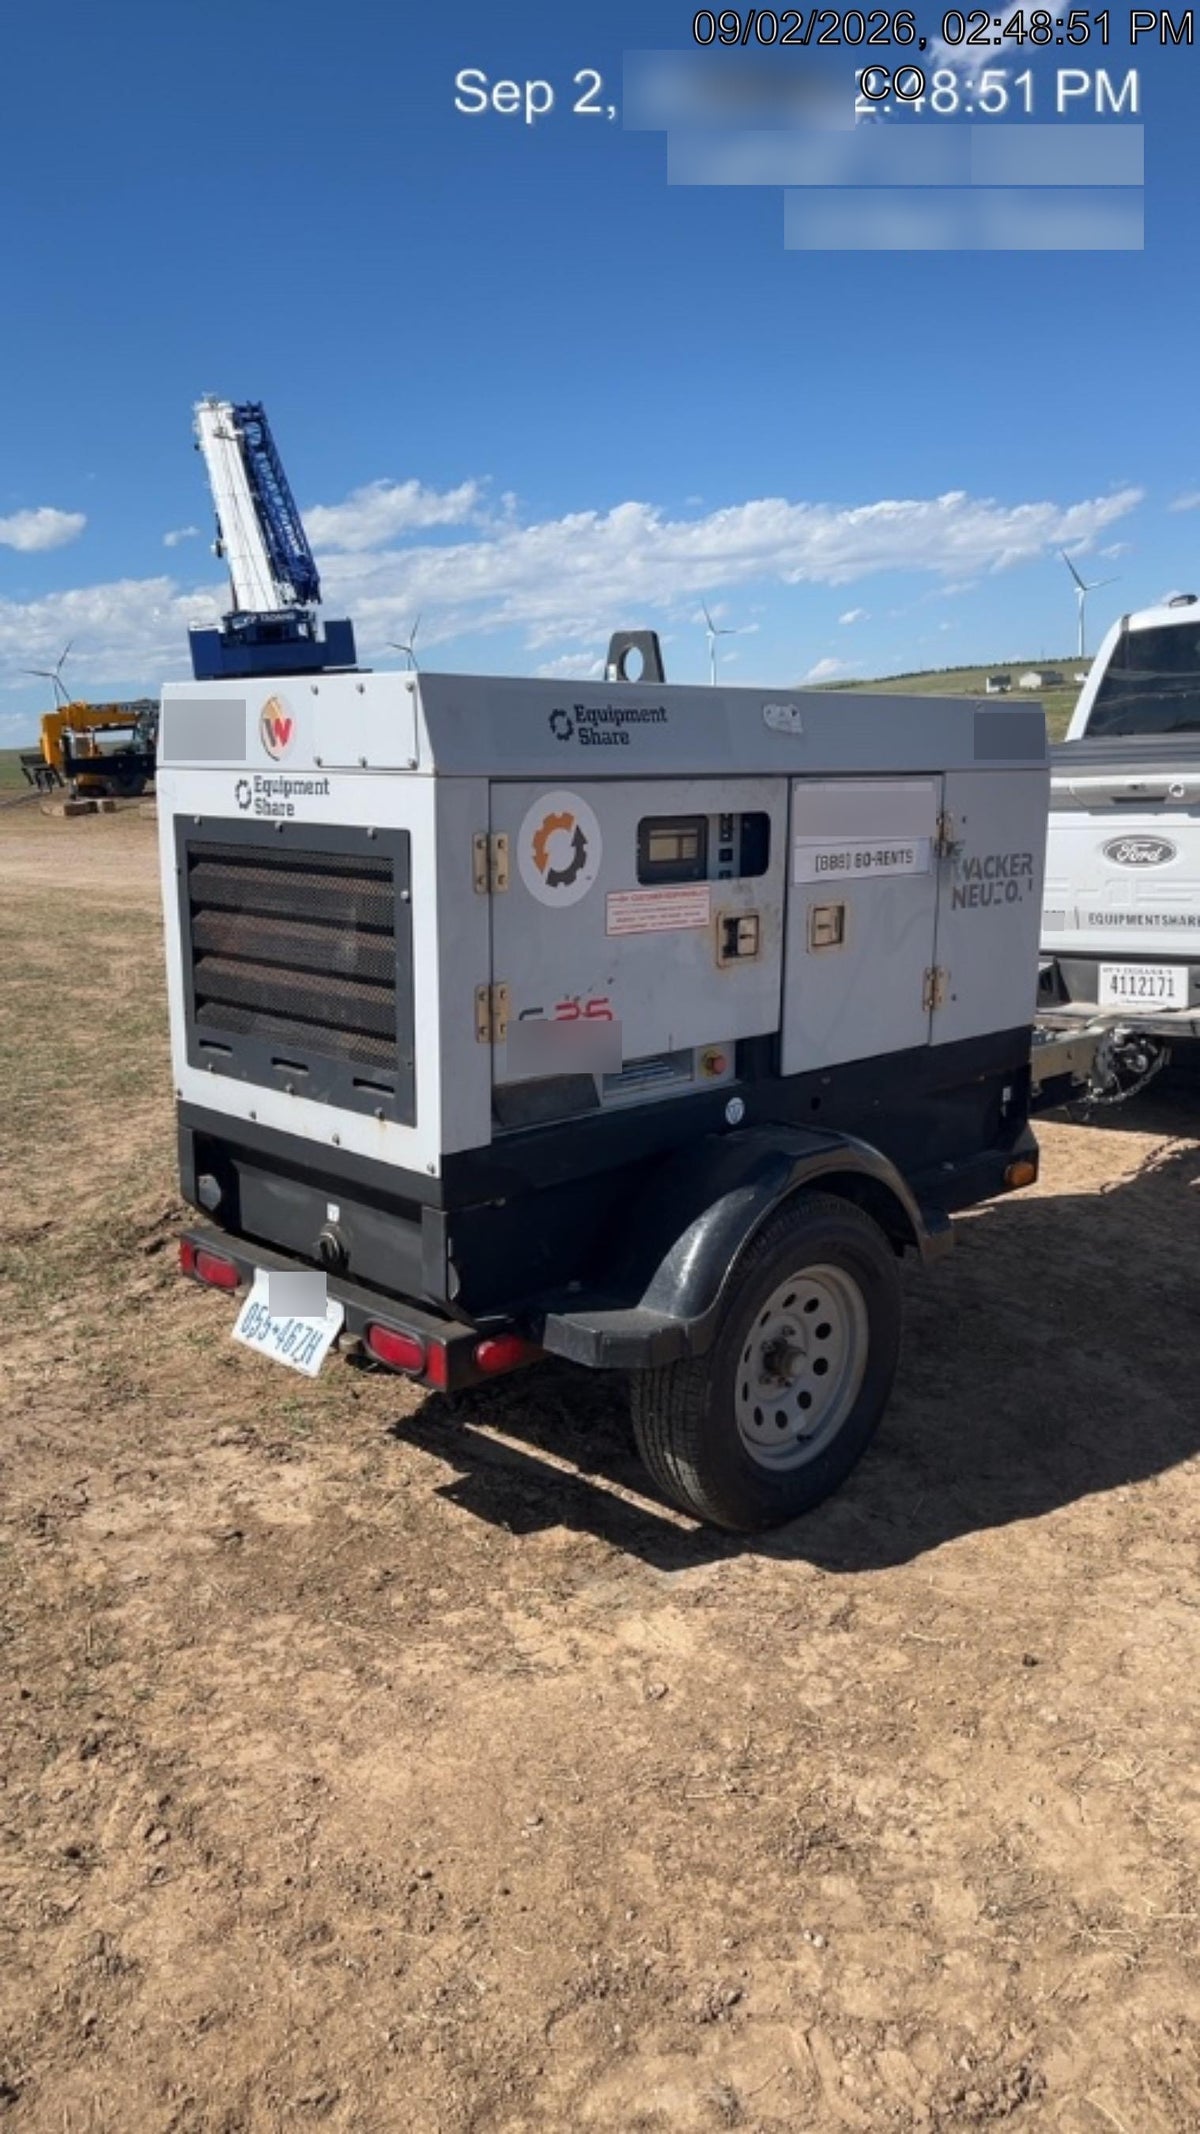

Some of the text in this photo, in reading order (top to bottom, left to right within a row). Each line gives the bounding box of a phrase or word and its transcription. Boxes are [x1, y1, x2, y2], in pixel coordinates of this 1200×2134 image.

[572, 703, 668, 726] Equipment
[578, 726, 631, 746] Share
[253, 774, 331, 797] Equipment
[254, 796, 296, 817] Share
[1110, 973, 1175, 997] 4112171
